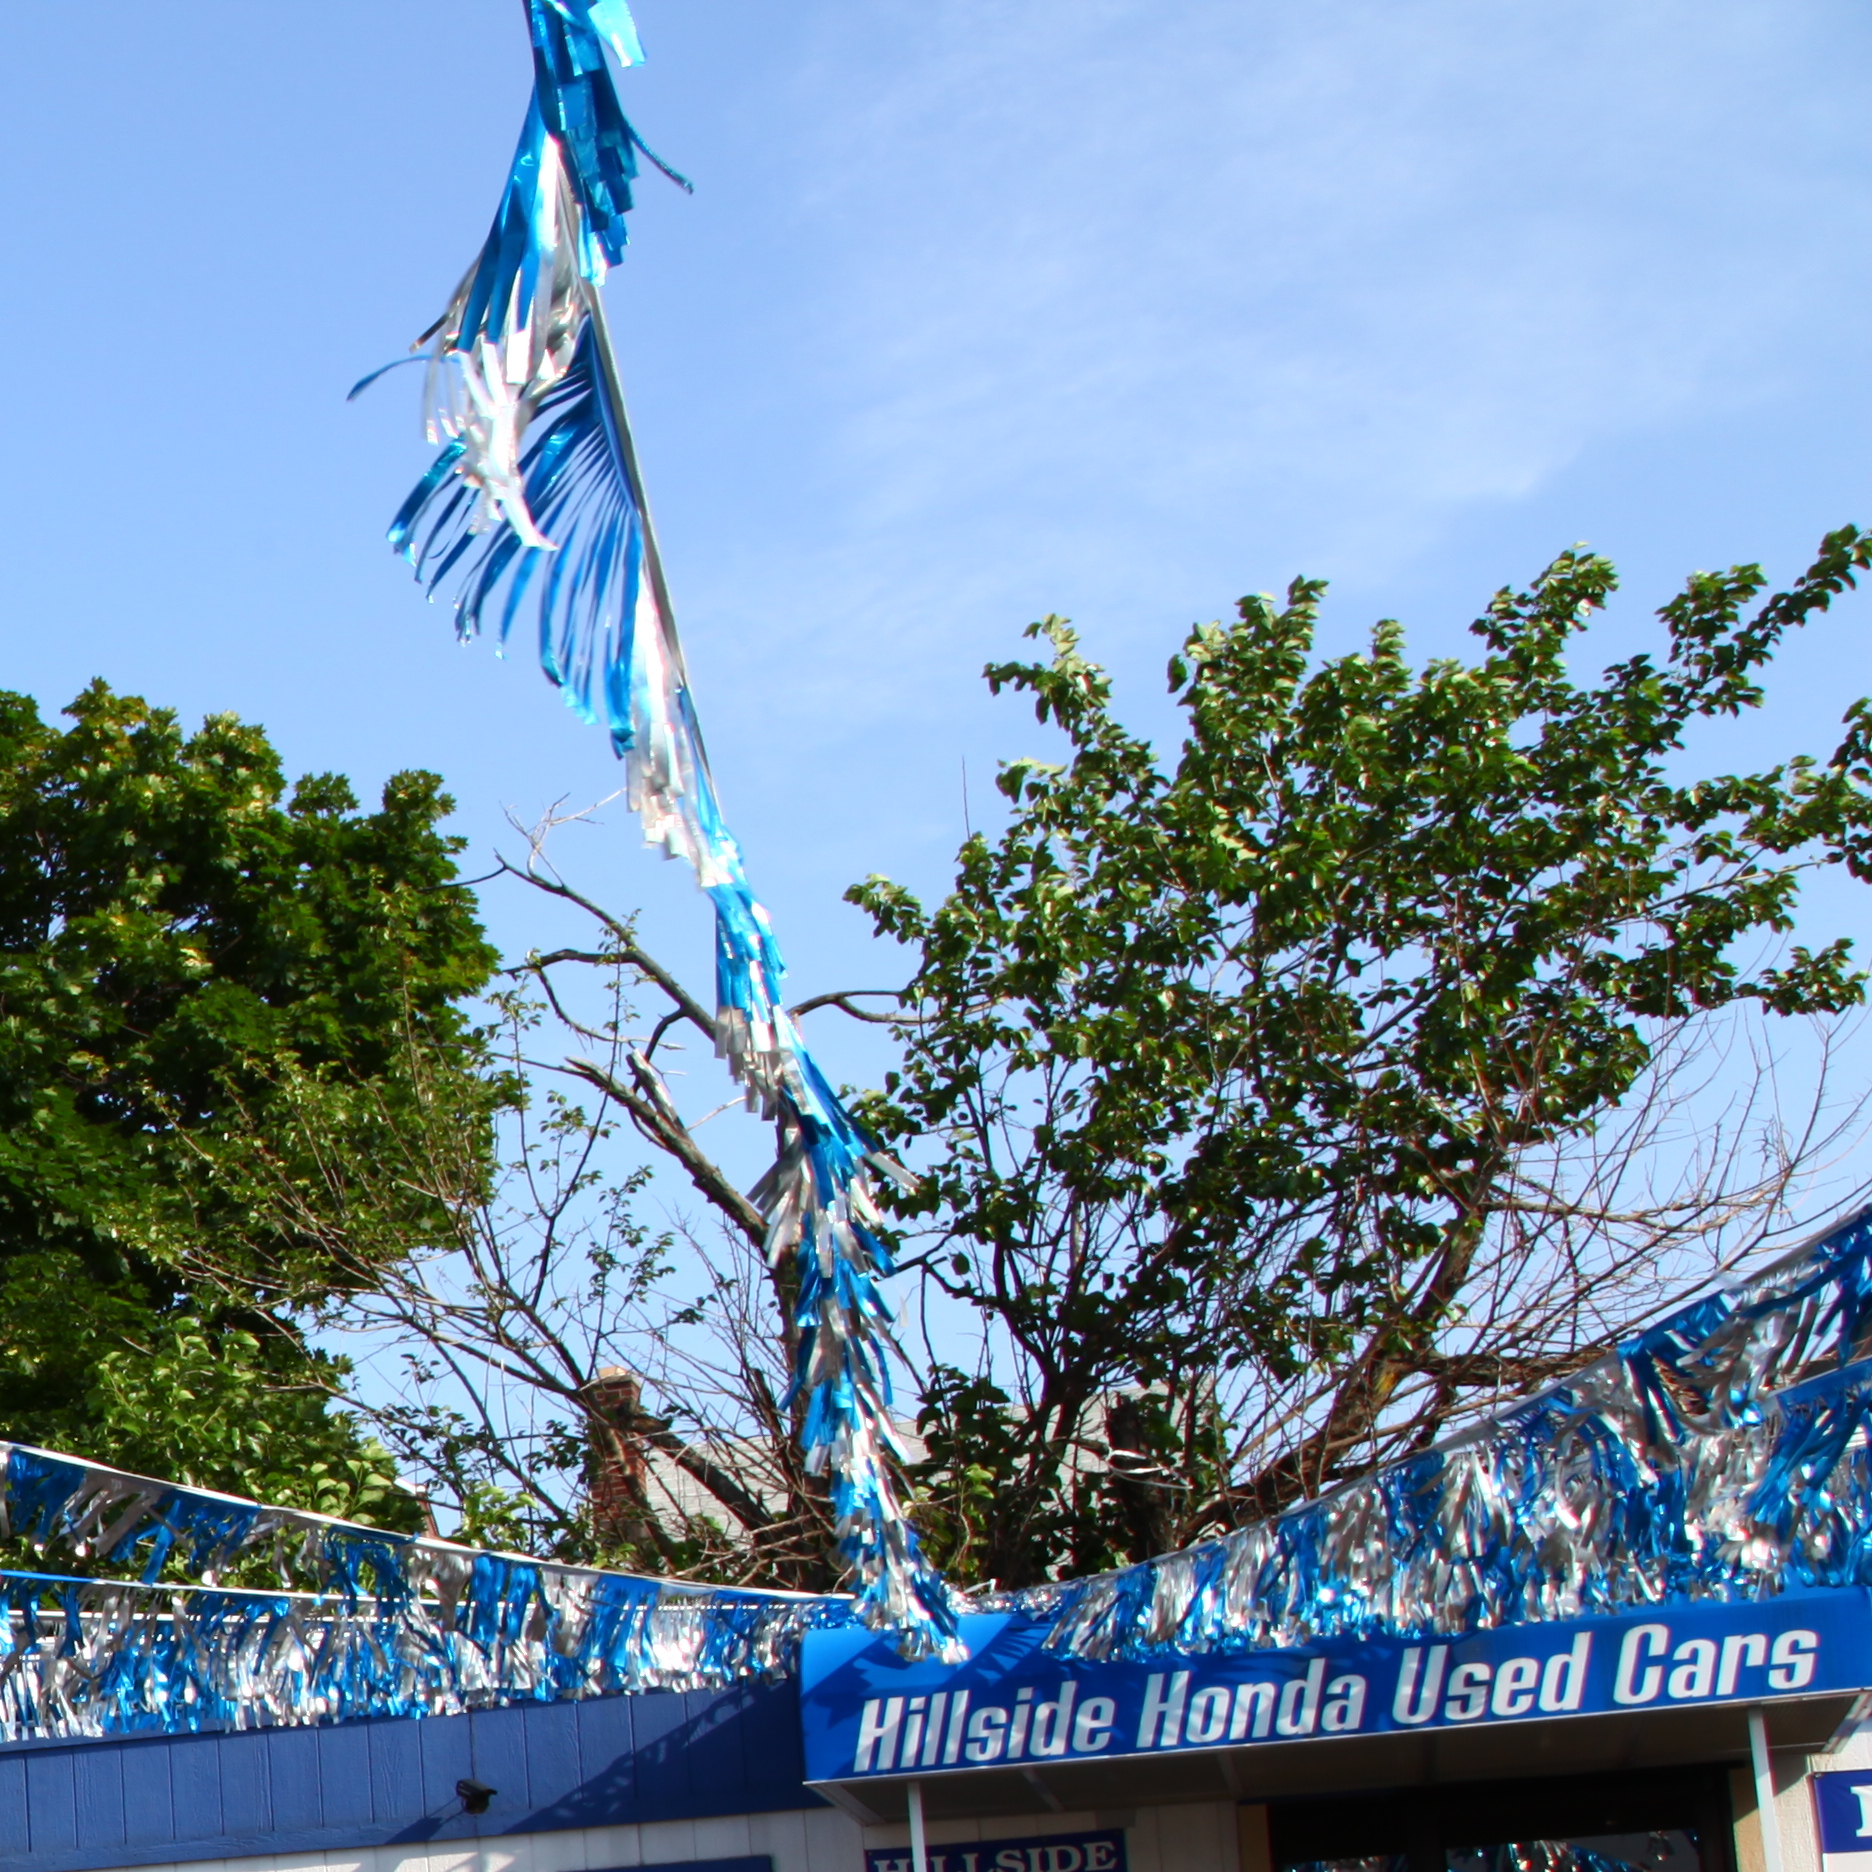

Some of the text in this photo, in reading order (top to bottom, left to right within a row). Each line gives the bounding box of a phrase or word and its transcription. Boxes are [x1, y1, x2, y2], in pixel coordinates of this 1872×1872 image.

[854, 1623, 1820, 1772] Hillside Honda Used Cars
